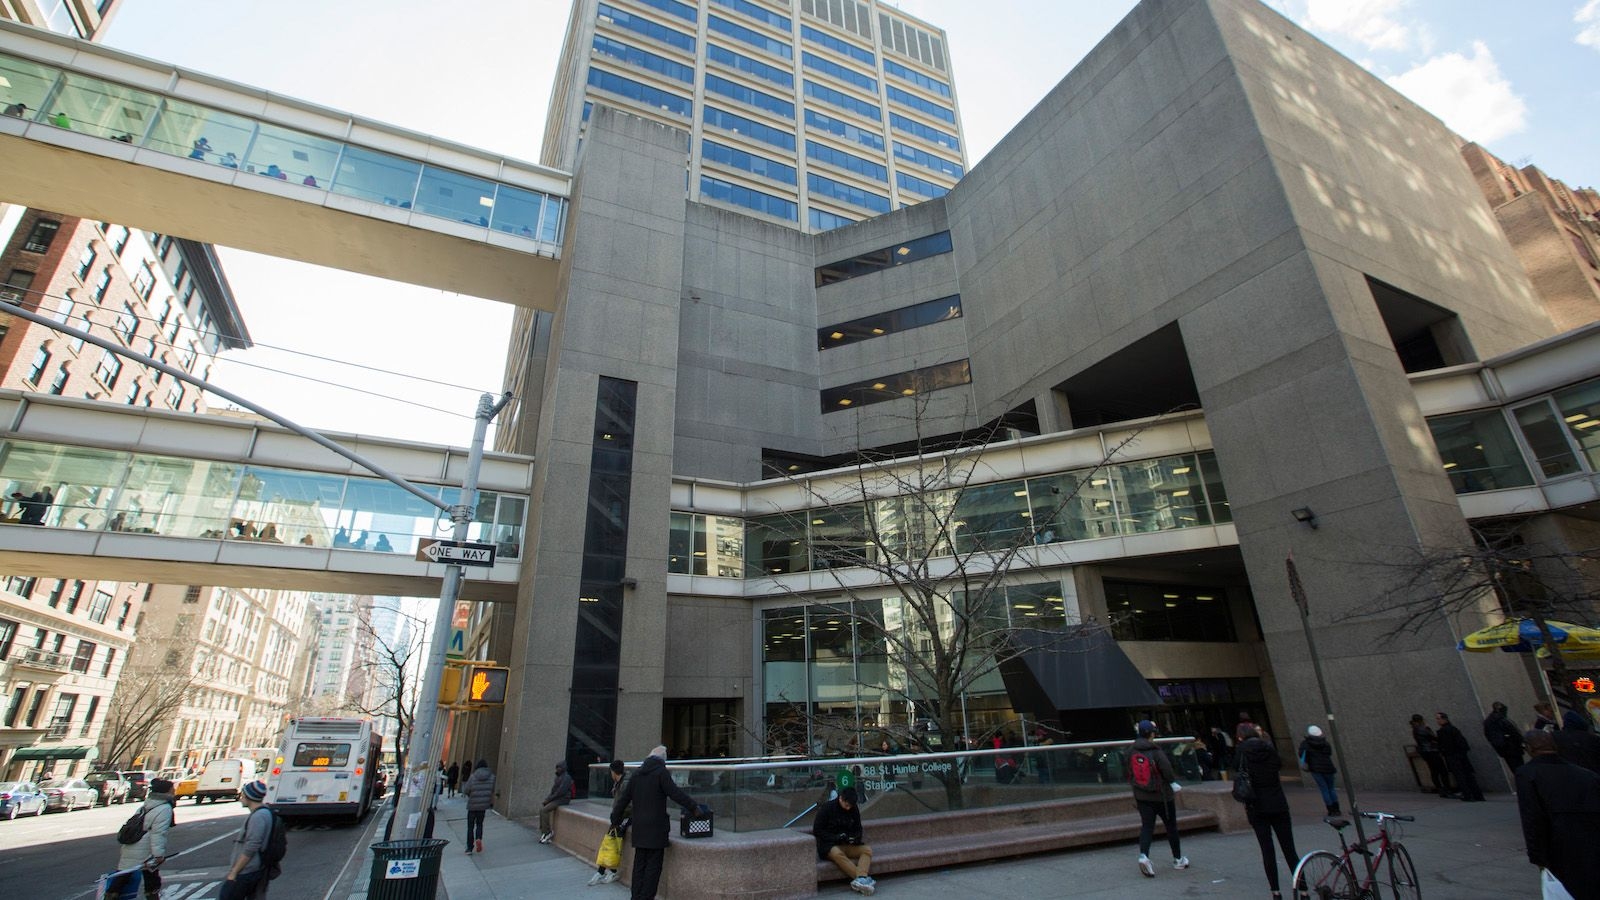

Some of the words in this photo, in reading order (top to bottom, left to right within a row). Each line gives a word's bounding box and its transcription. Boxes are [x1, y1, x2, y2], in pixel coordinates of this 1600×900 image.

[429, 546, 452, 557] ONE
[462, 549, 486, 560] WAY
[863, 766, 876, 776] 68
[879, 765, 891, 775] St.
[892, 764, 919, 774] Hunter
[921, 762, 952, 773] College
[841, 775, 849, 786] 6
[864, 780, 897, 791] Station
